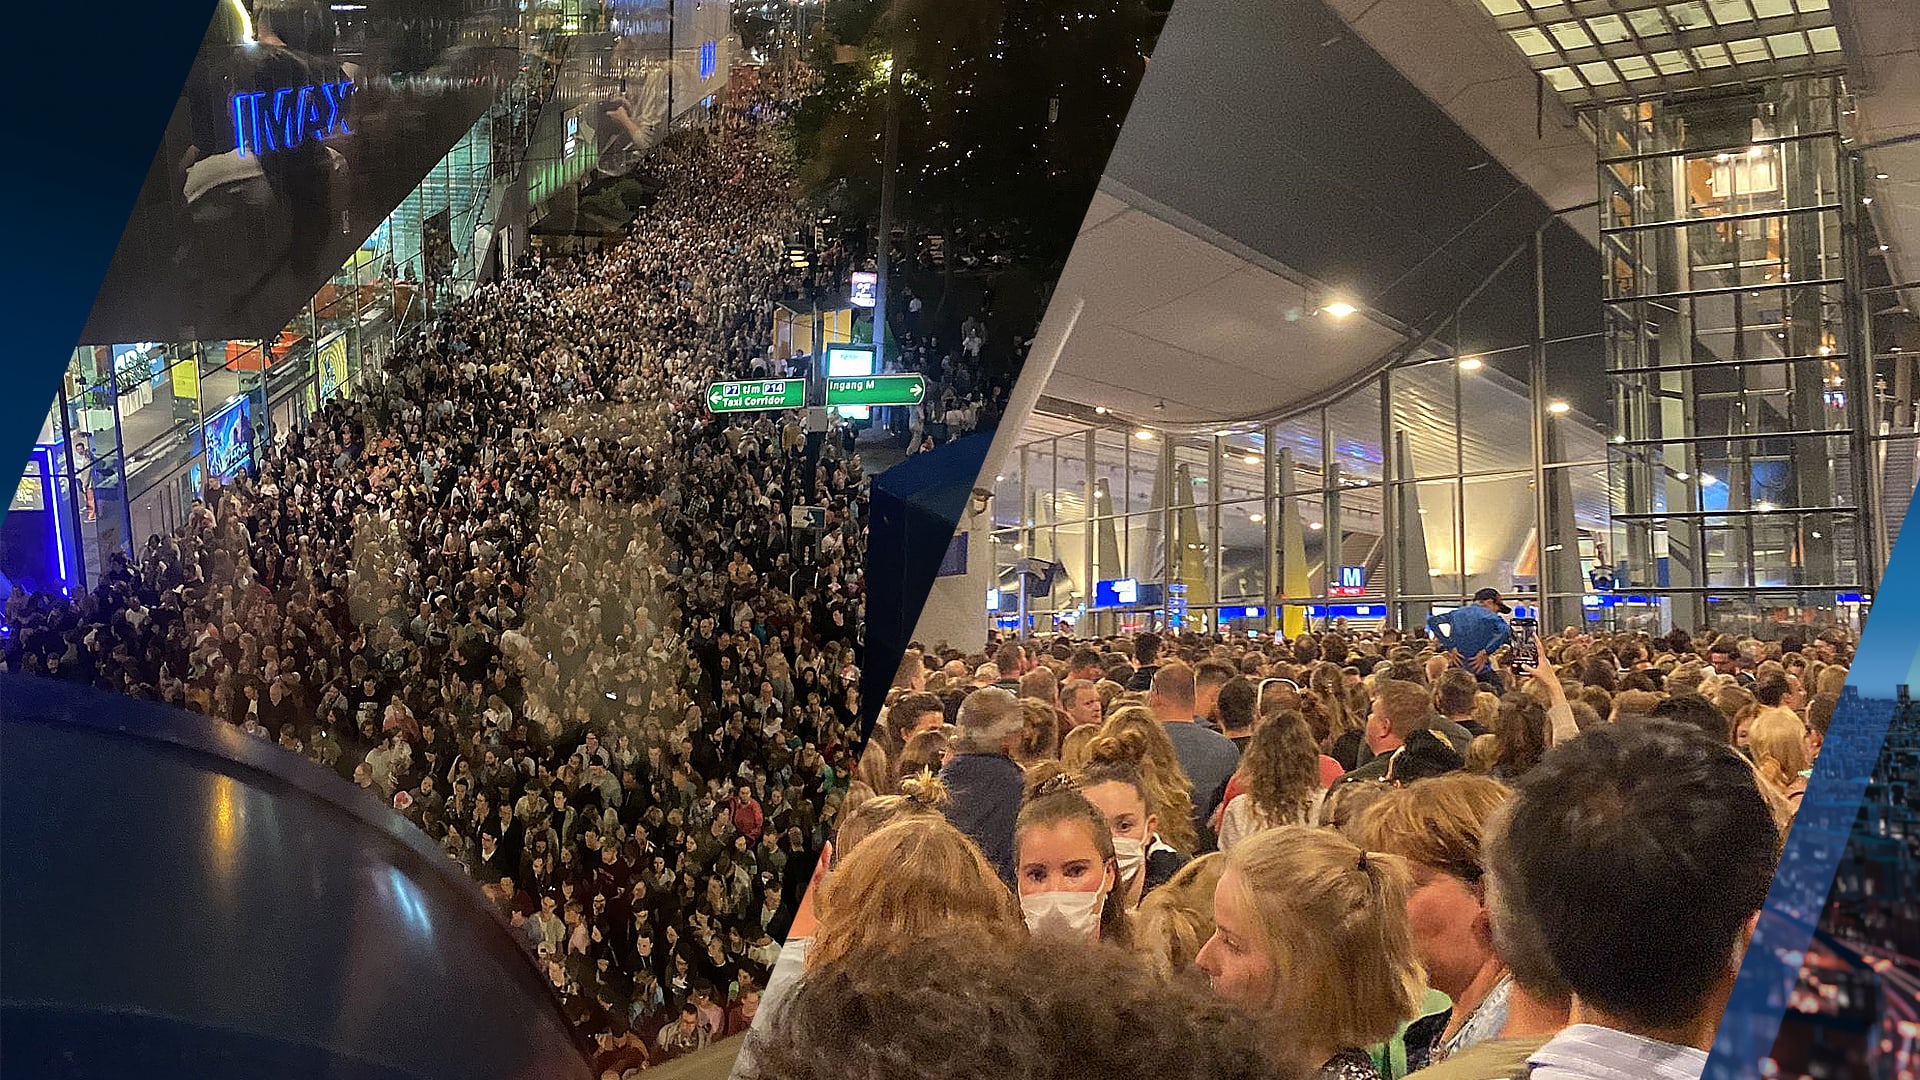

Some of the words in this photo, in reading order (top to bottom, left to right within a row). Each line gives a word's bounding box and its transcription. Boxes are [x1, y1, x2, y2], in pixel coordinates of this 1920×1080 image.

[232, 81, 354, 158] IMAX
[725, 385, 739, 395] P7
[742, 384, 760, 394] t/m
[764, 383, 784, 393] P14
[829, 381, 863, 392] Ingang
[865, 380, 875, 389] M
[722, 397, 742, 407] Taxi
[744, 396, 786, 406] Corridor
[1343, 568, 1361, 587] M
